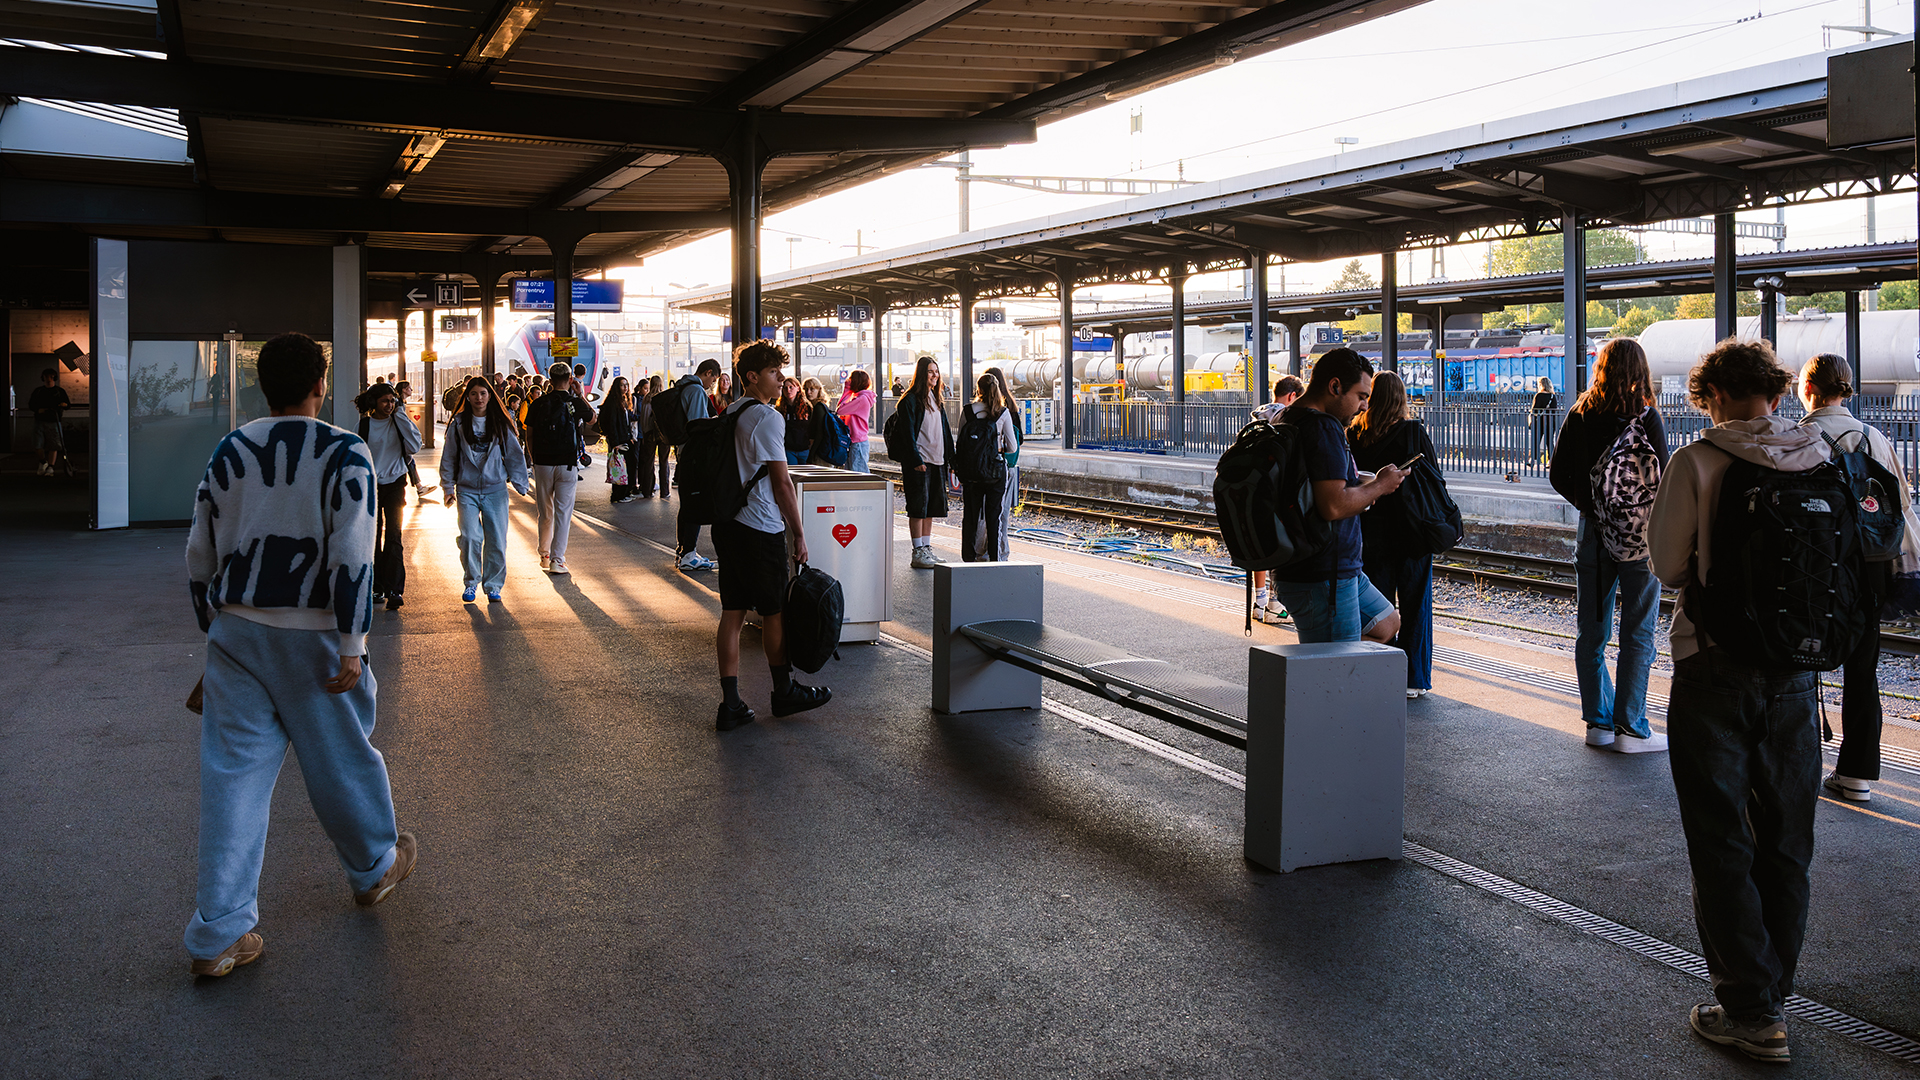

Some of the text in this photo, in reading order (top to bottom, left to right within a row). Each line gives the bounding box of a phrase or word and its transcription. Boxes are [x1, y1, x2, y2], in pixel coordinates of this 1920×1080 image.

[843, 310, 867, 319] 2 B
[980, 312, 1002, 321] B 3
[446, 321, 471, 330] B 1
[1321, 332, 1340, 341] B 5
[818, 347, 824, 355] 2
